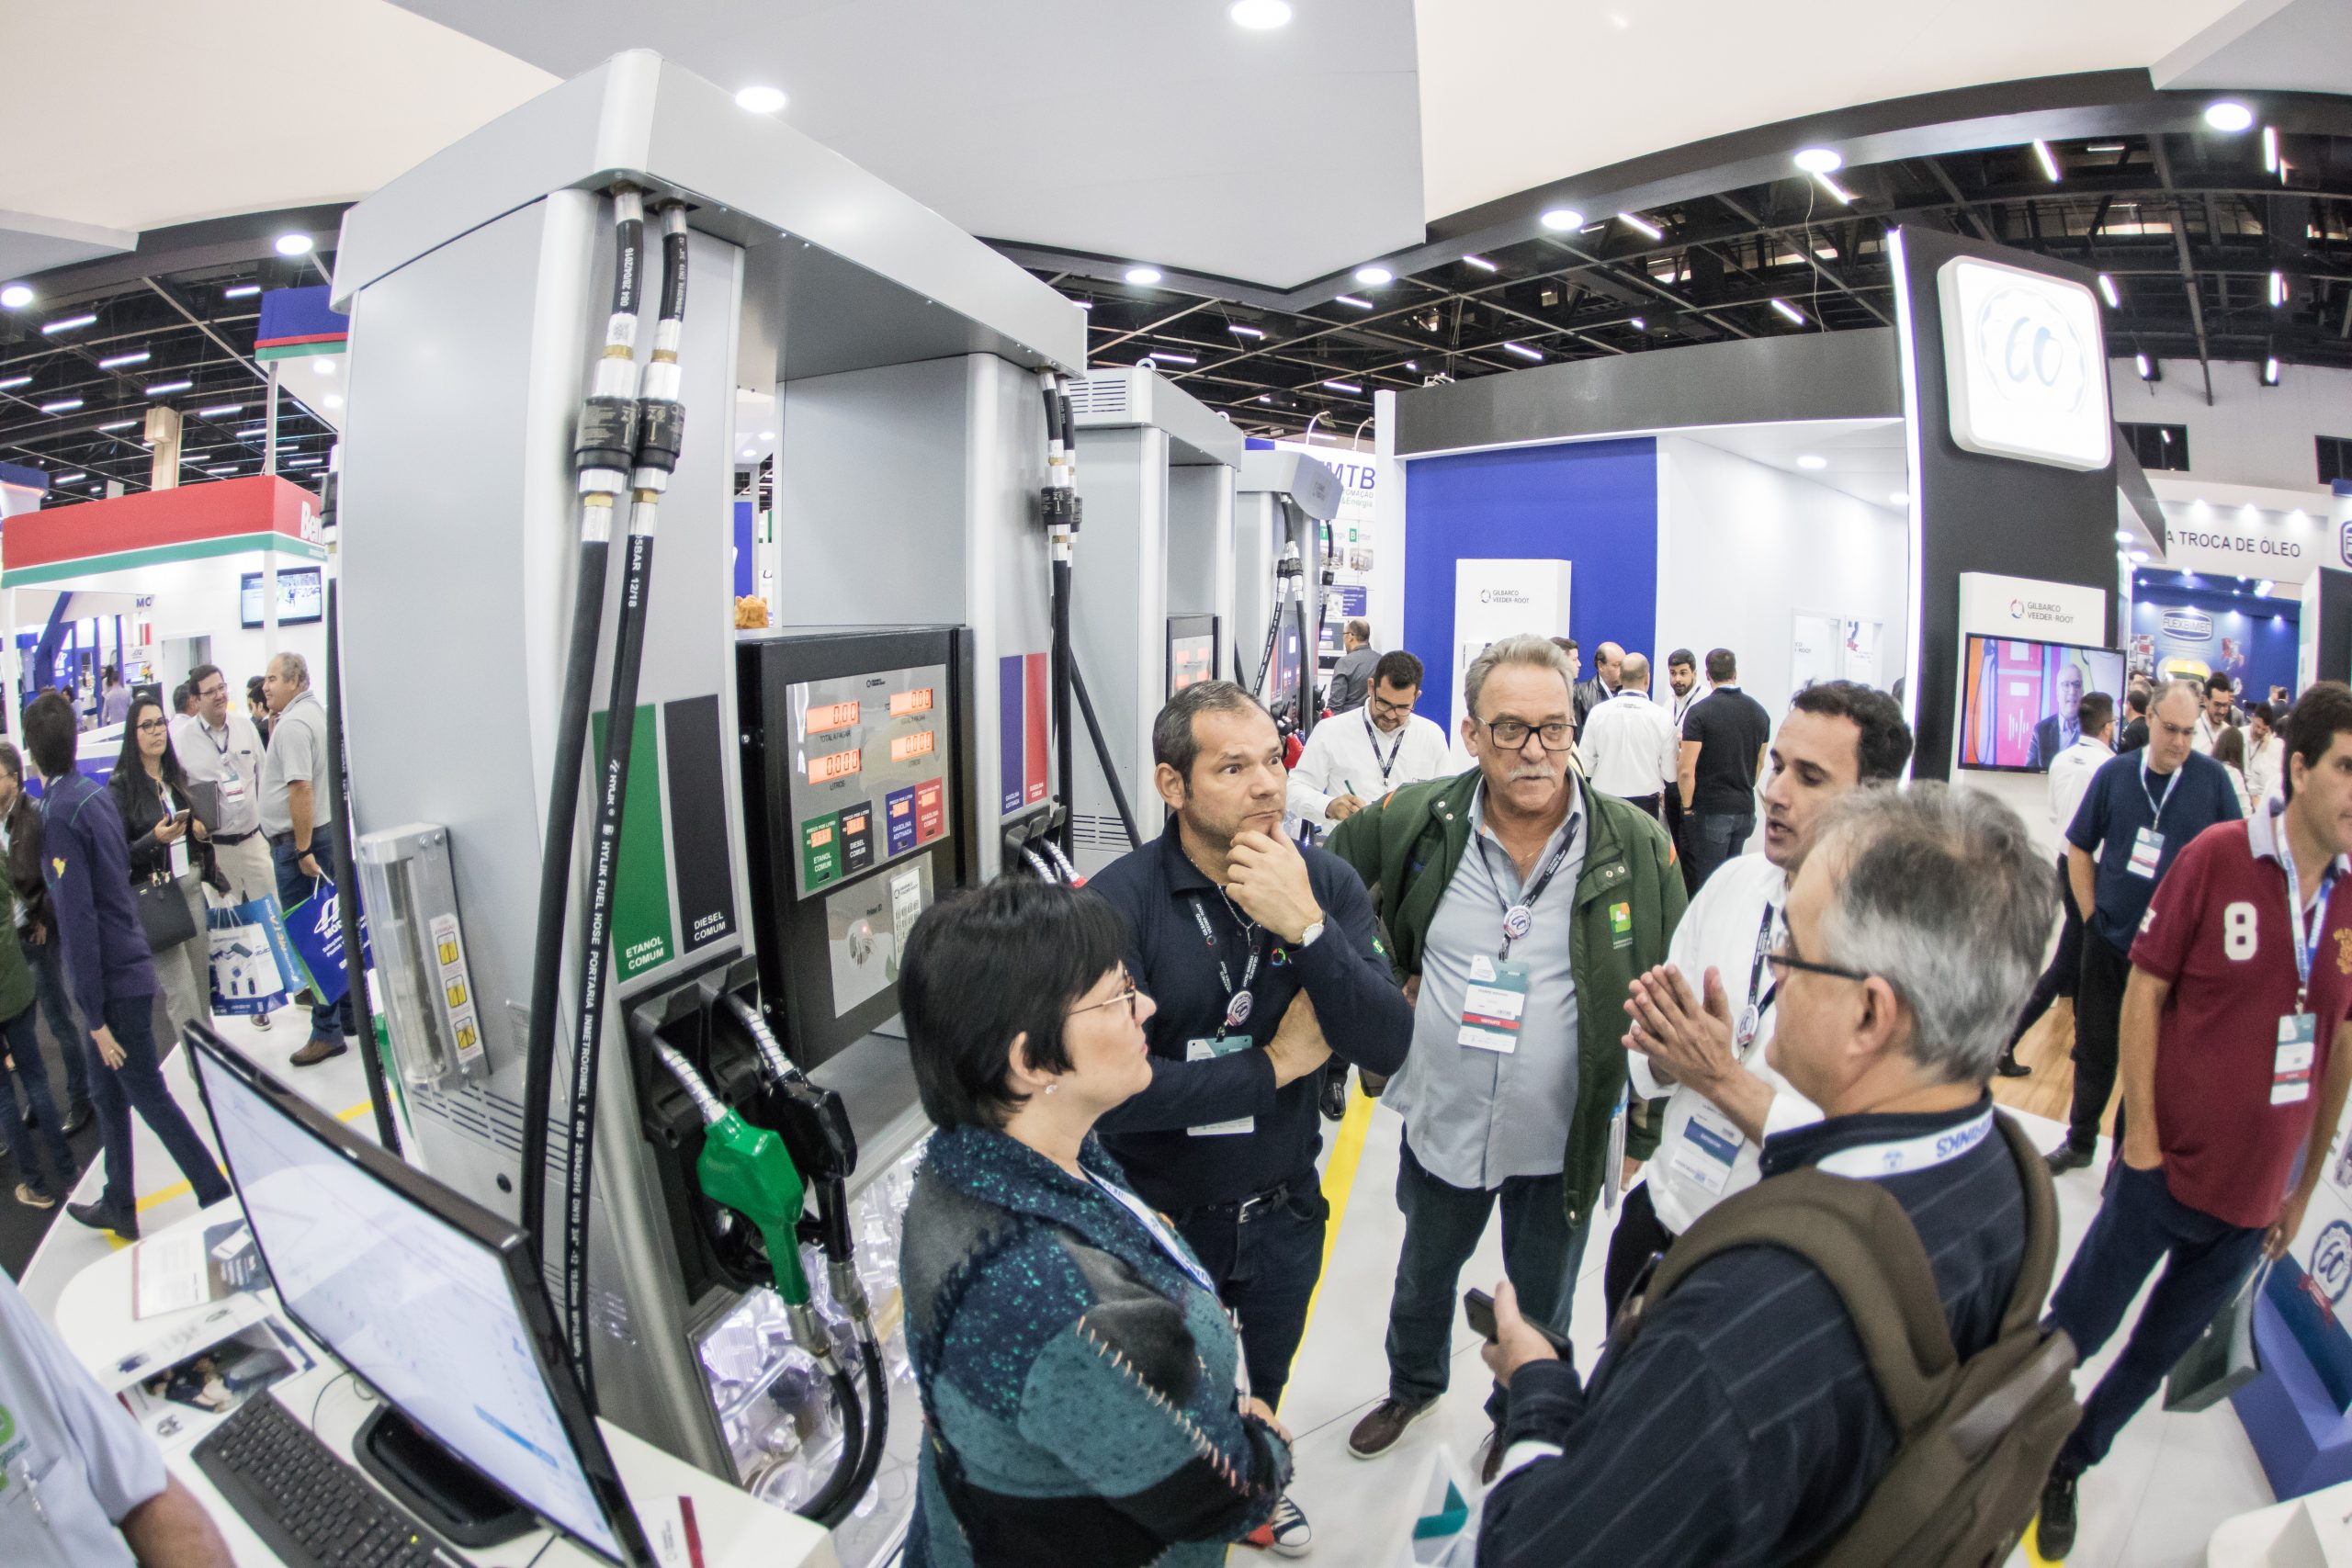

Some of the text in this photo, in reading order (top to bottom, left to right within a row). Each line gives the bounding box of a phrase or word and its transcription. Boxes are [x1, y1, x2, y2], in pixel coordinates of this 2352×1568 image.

[619, 247, 634, 307] 084 28/04/2016
[2179, 531, 2232, 550] TROCA
[2235, 537, 2256, 553] DE
[2260, 536, 2301, 558] ÓLEO
[628, 577, 640, 608] 12/18
[2027, 602, 2061, 613] GILBARCO
[606, 774, 616, 806] HYLIK
[598, 840, 611, 877] HYLIK
[813, 852, 831, 864] ETANOL
[814, 860, 832, 873] COMUM
[594, 879, 607, 910] FUEL
[591, 913, 603, 945] HOSE
[694, 911, 724, 930] DIESEL
[694, 921, 726, 942] COMUM
[2224, 902, 2257, 961] 8
[626, 936, 663, 958] ETANOL
[628, 947, 664, 970] COMUM
[585, 951, 599, 1010] PORTARIA
[578, 1013, 594, 1100] INMETRO/DIMEL
[575, 1120, 585, 1139] 084
[572, 1143, 584, 1194] 28/04/2016
